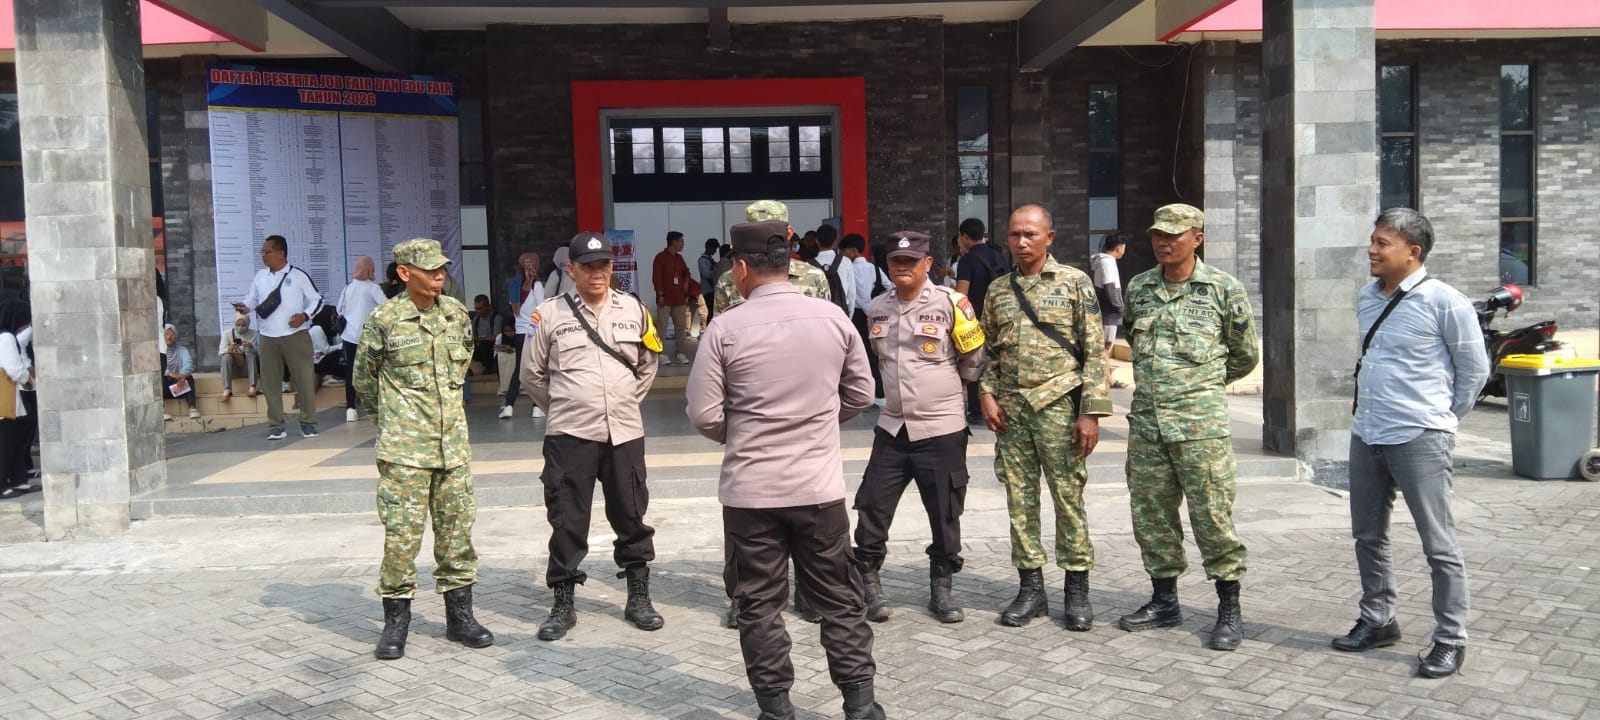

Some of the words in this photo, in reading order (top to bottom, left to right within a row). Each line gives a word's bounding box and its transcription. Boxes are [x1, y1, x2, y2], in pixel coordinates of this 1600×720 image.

[211, 69, 261, 85] DAFTAR
[263, 72, 318, 88] PESERTA
[320, 75, 343, 89] JOB
[345, 76, 373, 91] FAIR
[375, 78, 400, 92] DAN
[401, 80, 425, 94] EDU
[426, 82, 453, 96] FAIR
[298, 89, 341, 104] TAHUN
[343, 92, 376, 106] 2026
[1183, 308, 1198, 316] TNI
[1201, 310, 1214, 318] AD
[920, 314, 946, 323] POLRI
[612, 322, 637, 330] POLRI
